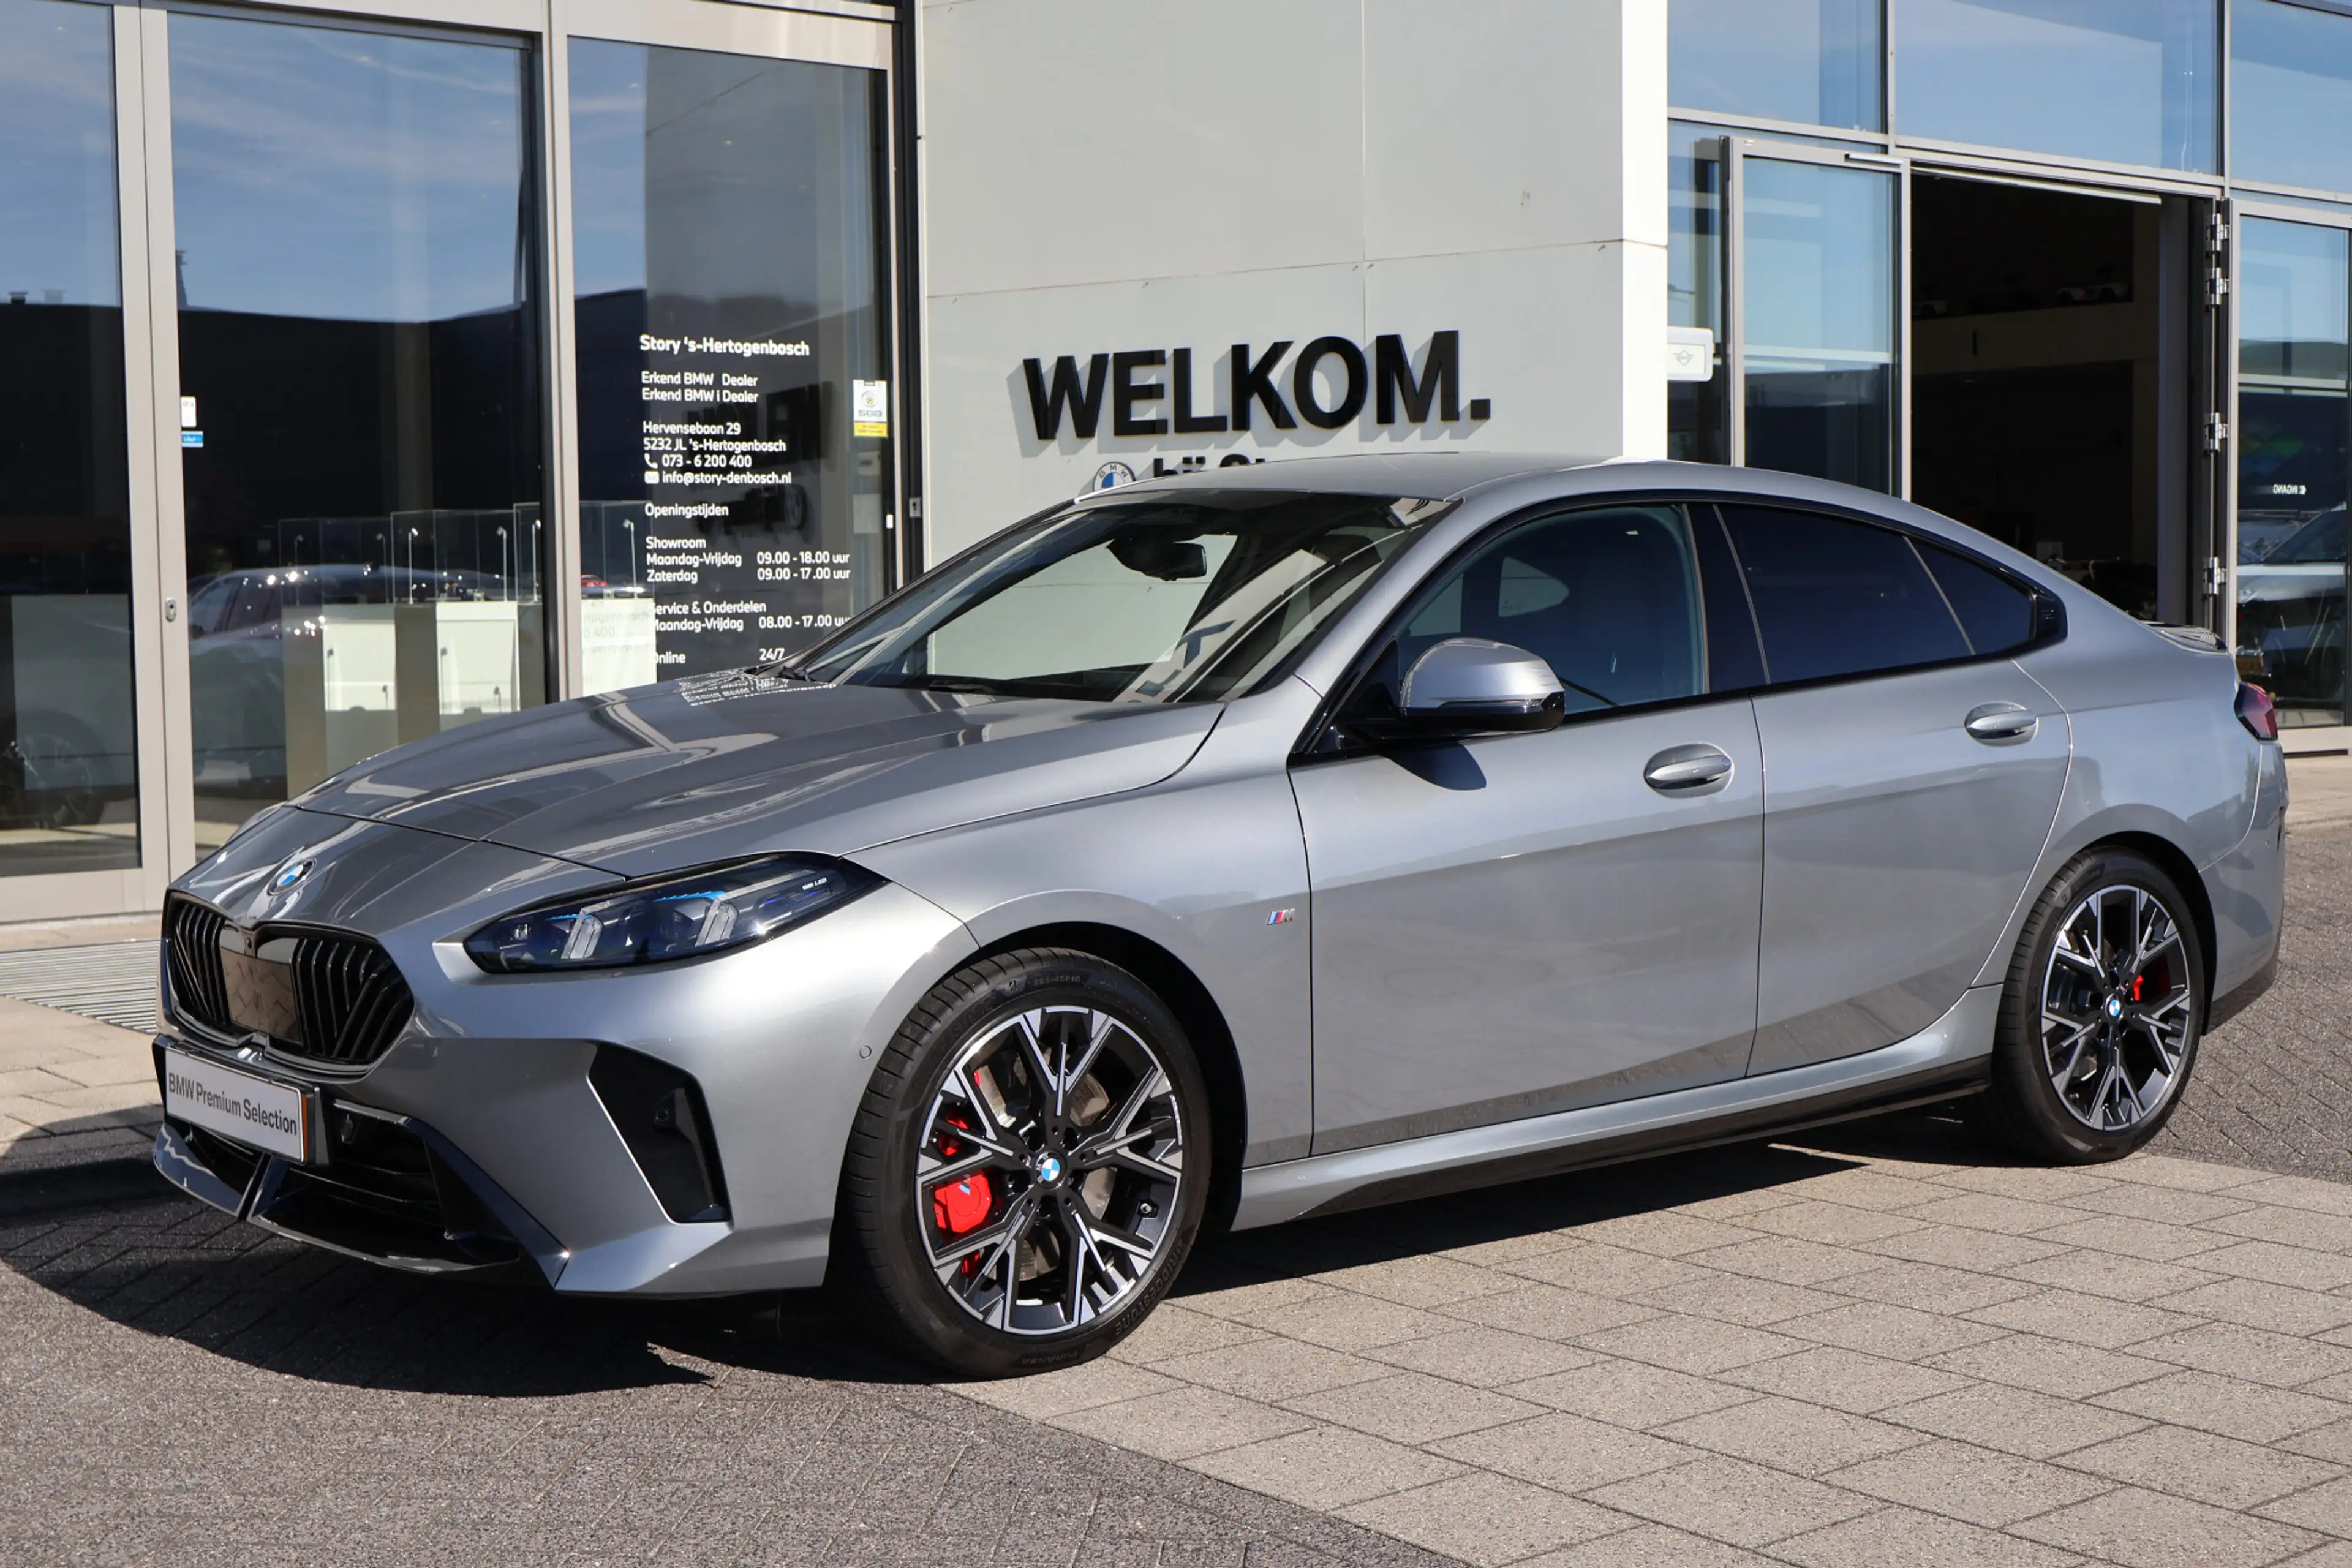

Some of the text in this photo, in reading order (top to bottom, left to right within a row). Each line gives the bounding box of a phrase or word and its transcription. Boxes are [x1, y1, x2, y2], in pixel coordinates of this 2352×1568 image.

[639, 334, 810, 358] Story 's-Hertogenbosch
[641, 371, 758, 387] Erkend BMW Dealer
[1023, 330, 1491, 440] WELKOM.
[642, 387, 759, 403] Erkend BMW i Dealer
[643, 420, 741, 435] Hervensebaan 29
[643, 437, 786, 454] 5232 JL 's-Hertogenbosch
[662, 453, 684, 467] 073
[694, 454, 702, 467] 6
[704, 454, 727, 467] 200
[729, 454, 752, 468] 400
[662, 470, 792, 486] info@story-denbosch.nl
[644, 502, 729, 519] Openingstijden
[646, 536, 706, 549] Showroom
[646, 552, 742, 568] Maandag-Vrijdag
[756, 551, 790, 565] 09.00
[799, 551, 831, 564] 18.00
[832, 553, 851, 564] uur
[647, 568, 698, 584] Zaterdag
[757, 567, 791, 581] 09.00
[799, 567, 831, 580] 17.00
[832, 569, 851, 579] uur
[691, 601, 701, 614] &
[703, 600, 767, 614] Onderdelen
[758, 615, 793, 629] 08.00
[801, 614, 832, 627] 17.00
[759, 647, 785, 661] 24/7
[168, 1072, 298, 1136] BMW Premium Selection
